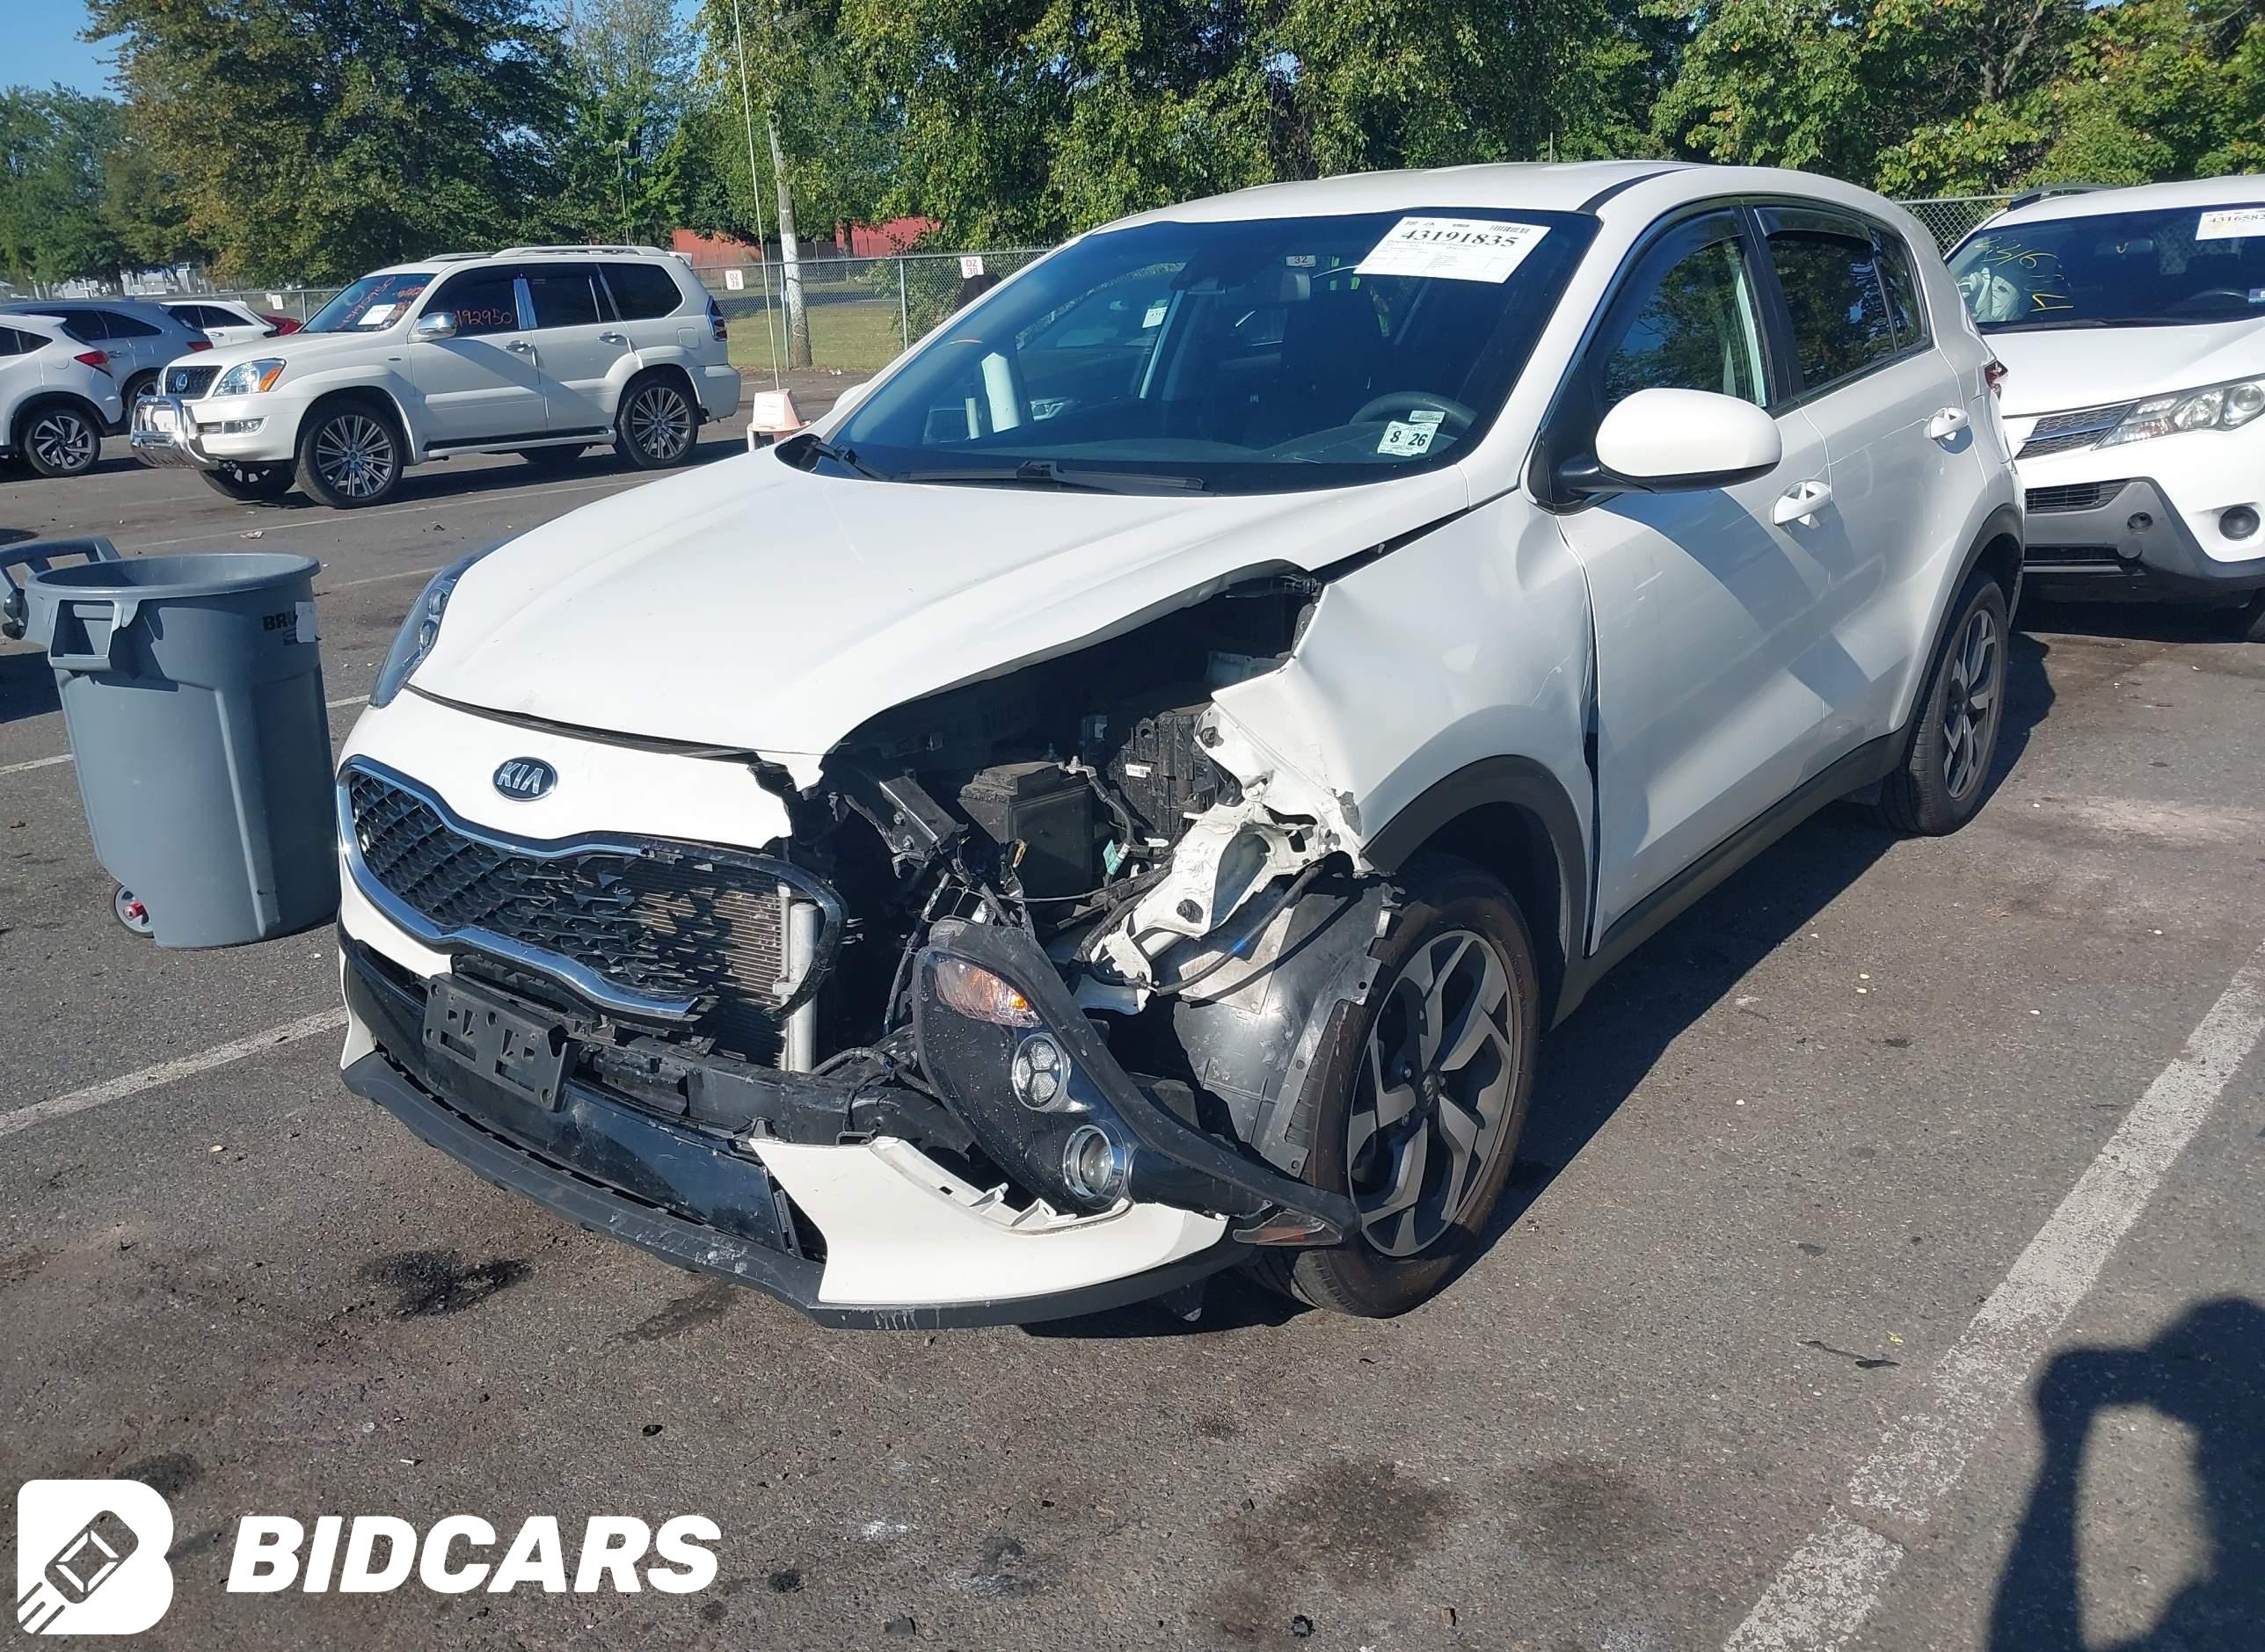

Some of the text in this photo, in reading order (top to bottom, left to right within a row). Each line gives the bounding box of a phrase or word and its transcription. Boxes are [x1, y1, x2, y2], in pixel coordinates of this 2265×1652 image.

[1402, 229, 1520, 247] 43191835
[1389, 430, 1429, 447] 8 26
[497, 761, 544, 795] KIA
